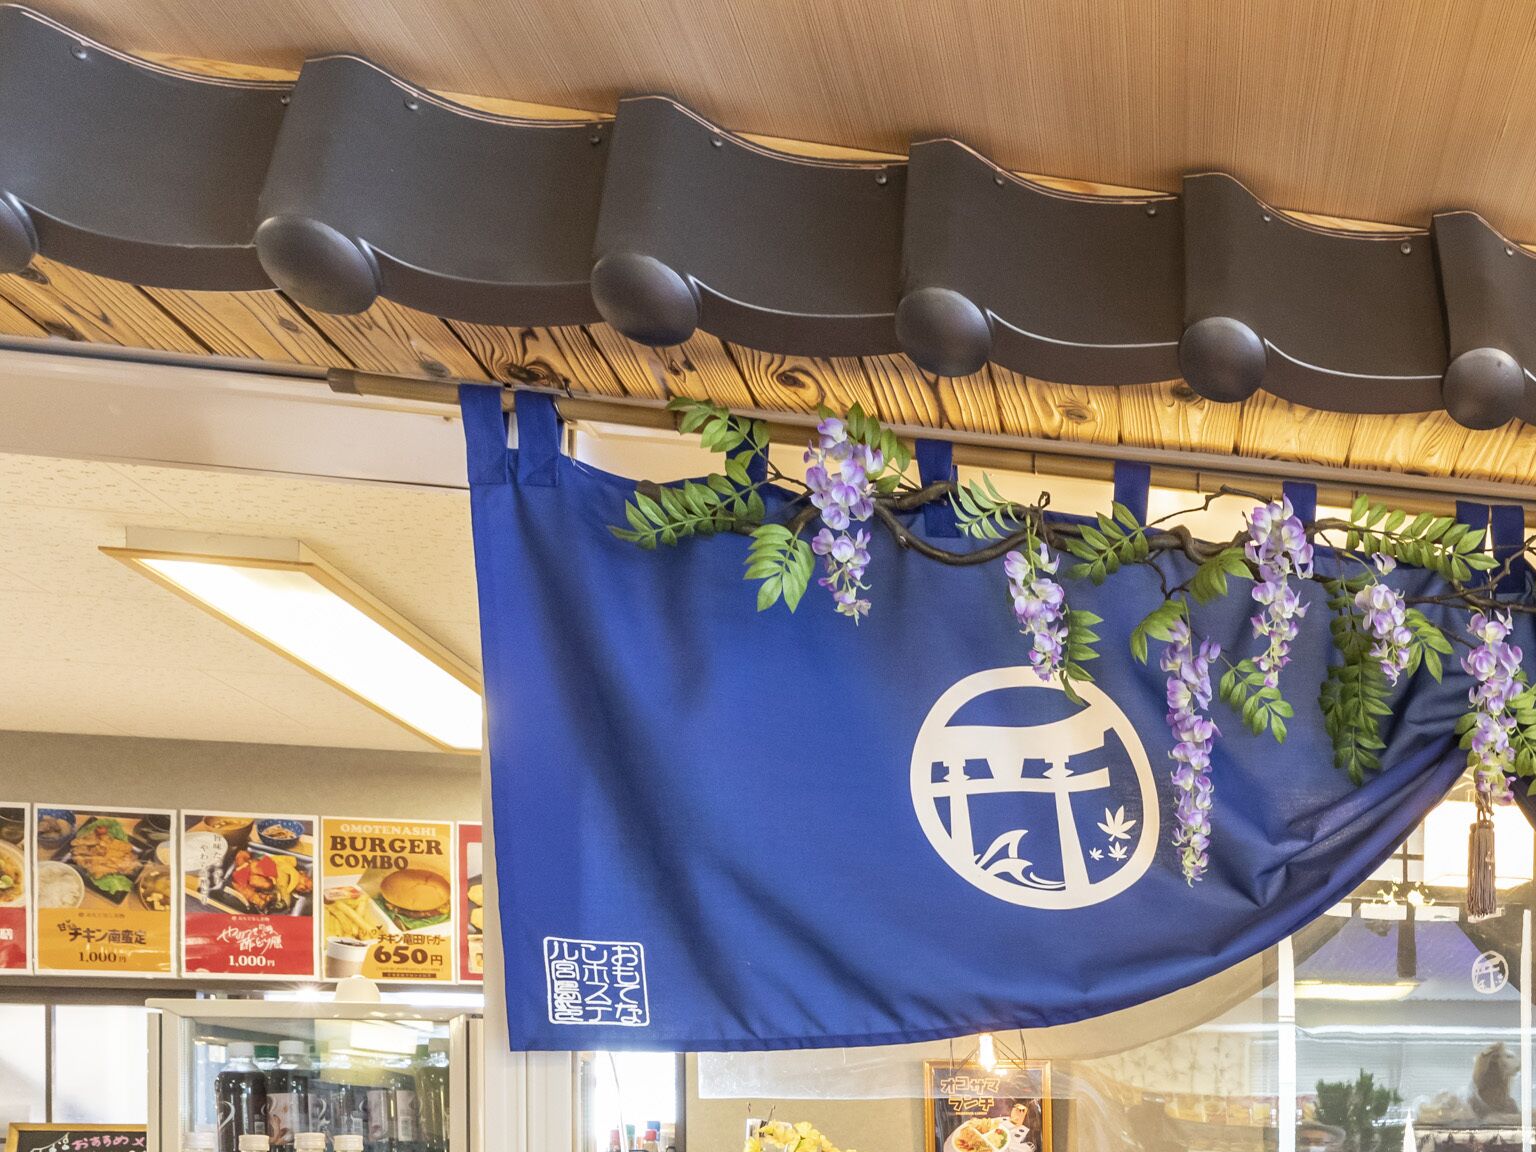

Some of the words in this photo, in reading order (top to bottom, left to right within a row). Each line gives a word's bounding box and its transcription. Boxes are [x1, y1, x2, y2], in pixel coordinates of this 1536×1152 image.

[340, 823, 436, 837] OMOTENASHI
[330, 835, 443, 855] BURGER
[330, 853, 408, 870] COMBO
[941, 1076, 1001, 1095] オコサマ
[949, 1094, 994, 1112] ランチ
